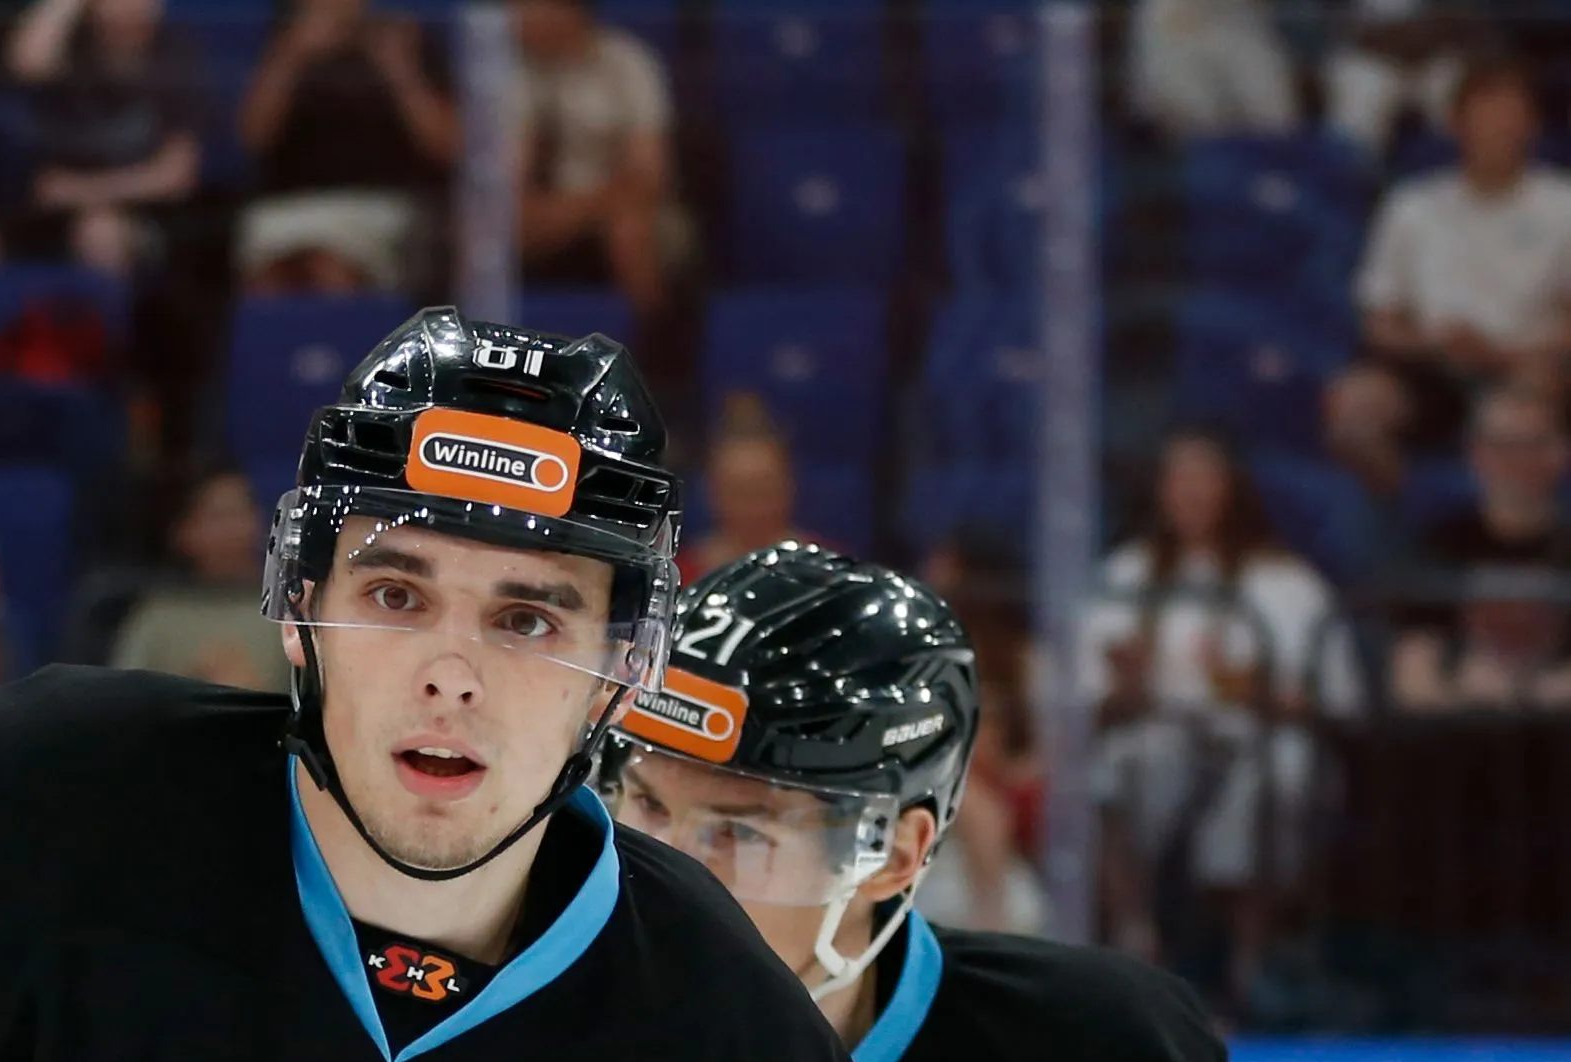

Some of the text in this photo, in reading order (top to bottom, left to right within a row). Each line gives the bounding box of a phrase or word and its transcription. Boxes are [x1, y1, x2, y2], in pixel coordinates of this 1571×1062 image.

[433, 440, 527, 477] Winline
[677, 606, 756, 667] 21
[881, 713, 944, 748] BAUER
[367, 953, 461, 993] KHL
